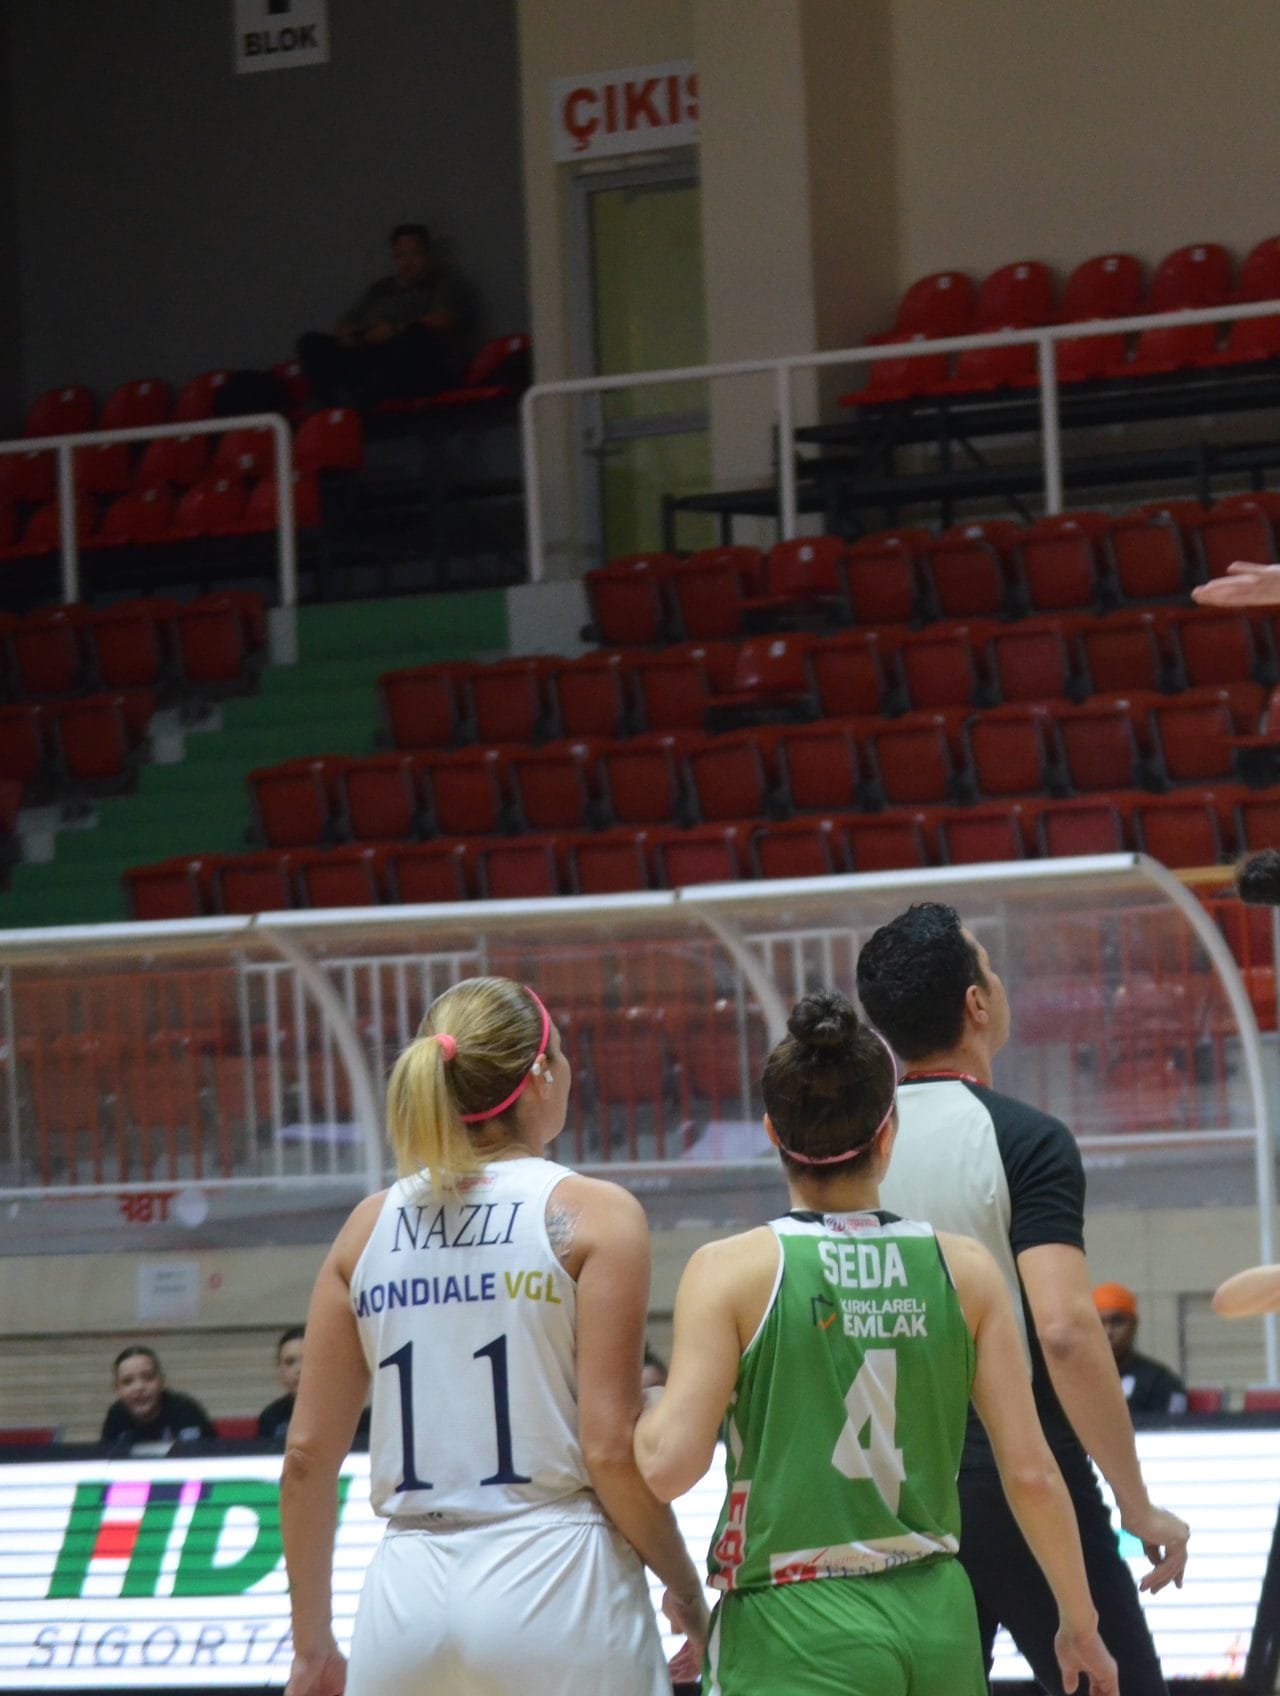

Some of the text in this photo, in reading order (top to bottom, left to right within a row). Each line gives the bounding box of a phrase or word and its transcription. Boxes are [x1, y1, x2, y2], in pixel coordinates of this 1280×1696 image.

[244, 23, 319, 57] BLOK
[391, 1201, 524, 1252] NAZLI
[818, 1240, 909, 1289] SEDA
[353, 1270, 562, 1318] MONDIALE VGL
[843, 1313, 929, 1338] EMLAK
[379, 1333, 534, 1494] 11
[831, 1348, 907, 1518] 4
